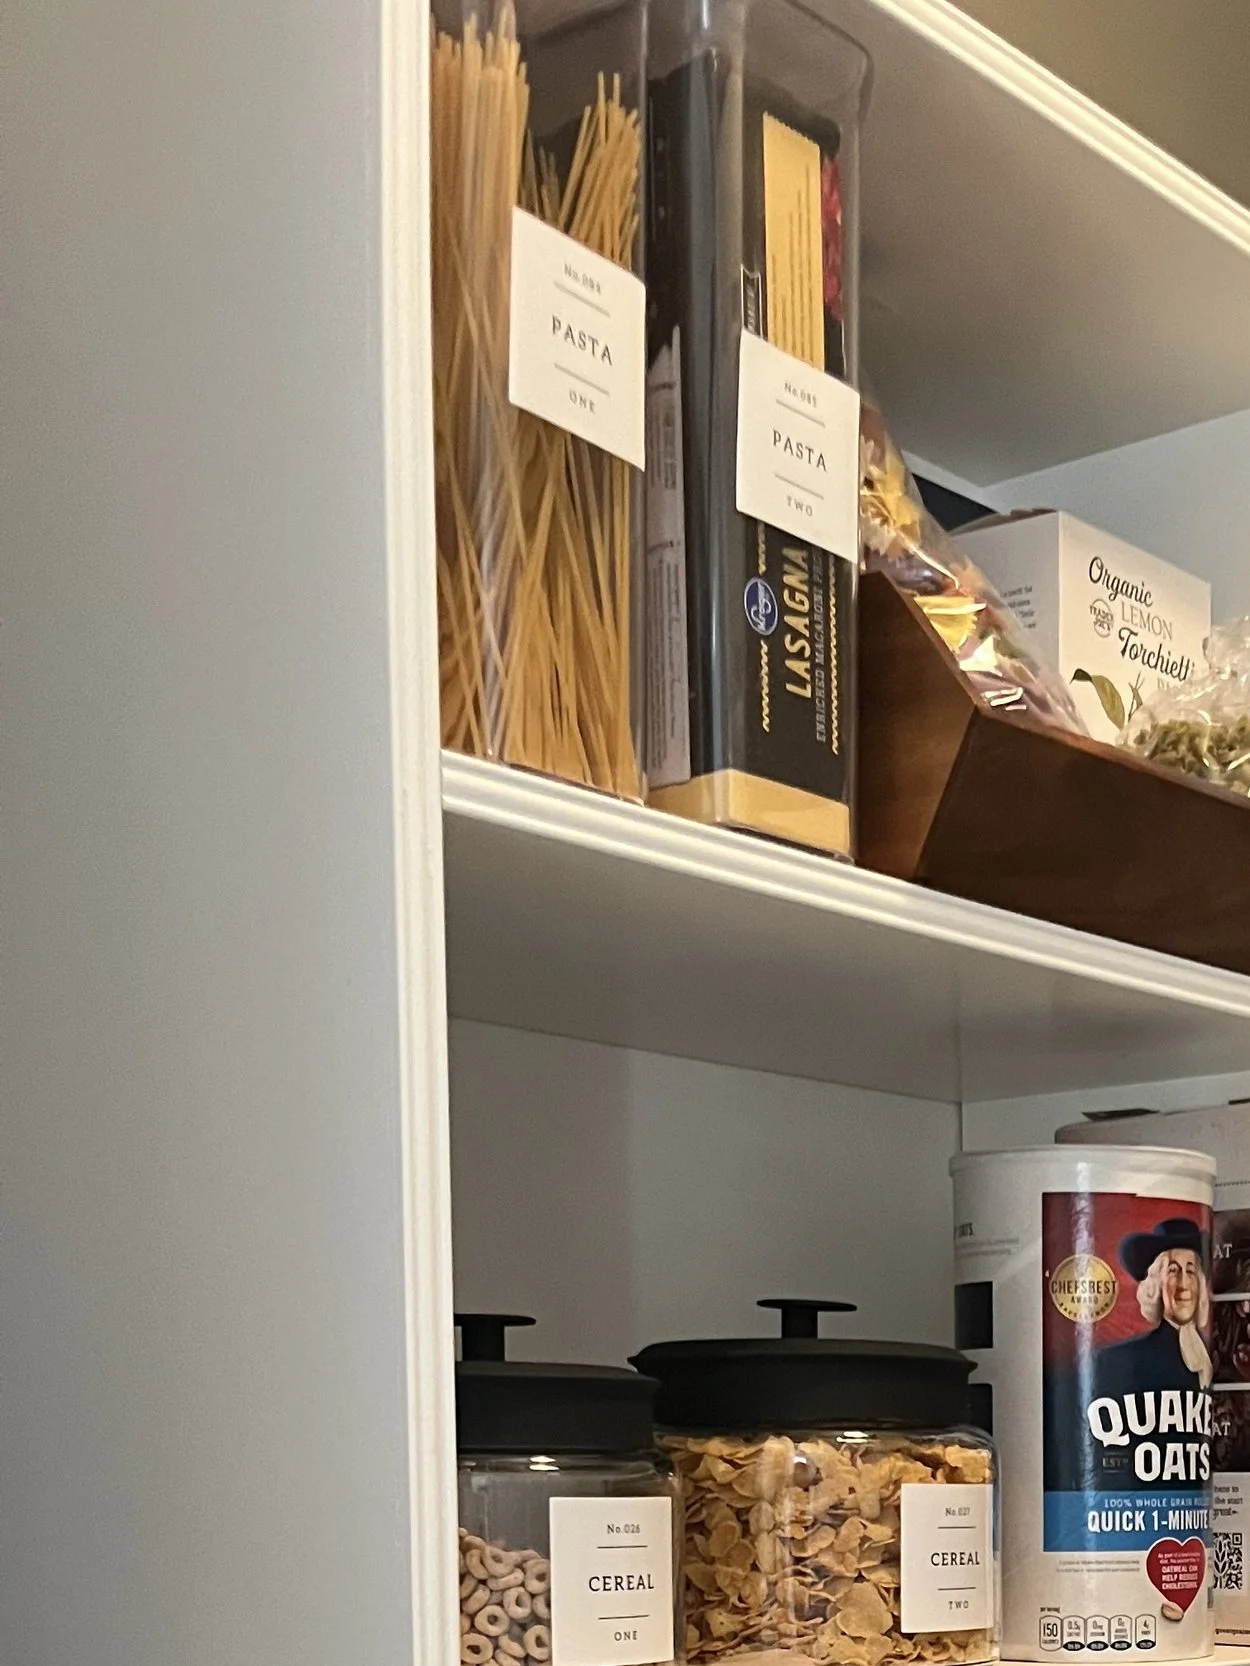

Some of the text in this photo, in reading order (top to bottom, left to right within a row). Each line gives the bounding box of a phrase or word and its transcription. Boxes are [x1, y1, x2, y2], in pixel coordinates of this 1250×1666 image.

[552, 315, 613, 366] PASTA
[569, 388, 595, 414] ONE
[772, 428, 827, 472] PASTA
[786, 495, 813, 517] TWO
[1089, 556, 1153, 607] Organic
[1121, 601, 1172, 640] LEMON
[1134, 1442, 1210, 1482] OATS
[1104, 1498, 1132, 1508] 100%
[1135, 1497, 1167, 1508] WHOLE
[1088, 1508, 1209, 1533] QUICK 1-MINUTE
[930, 1551, 981, 1568] CEREAL
[589, 1574, 655, 1592] CEREAL
[948, 1600, 970, 1610] TWO
[613, 1630, 639, 1642] ONE
[1042, 1623, 1058, 1637] 150
